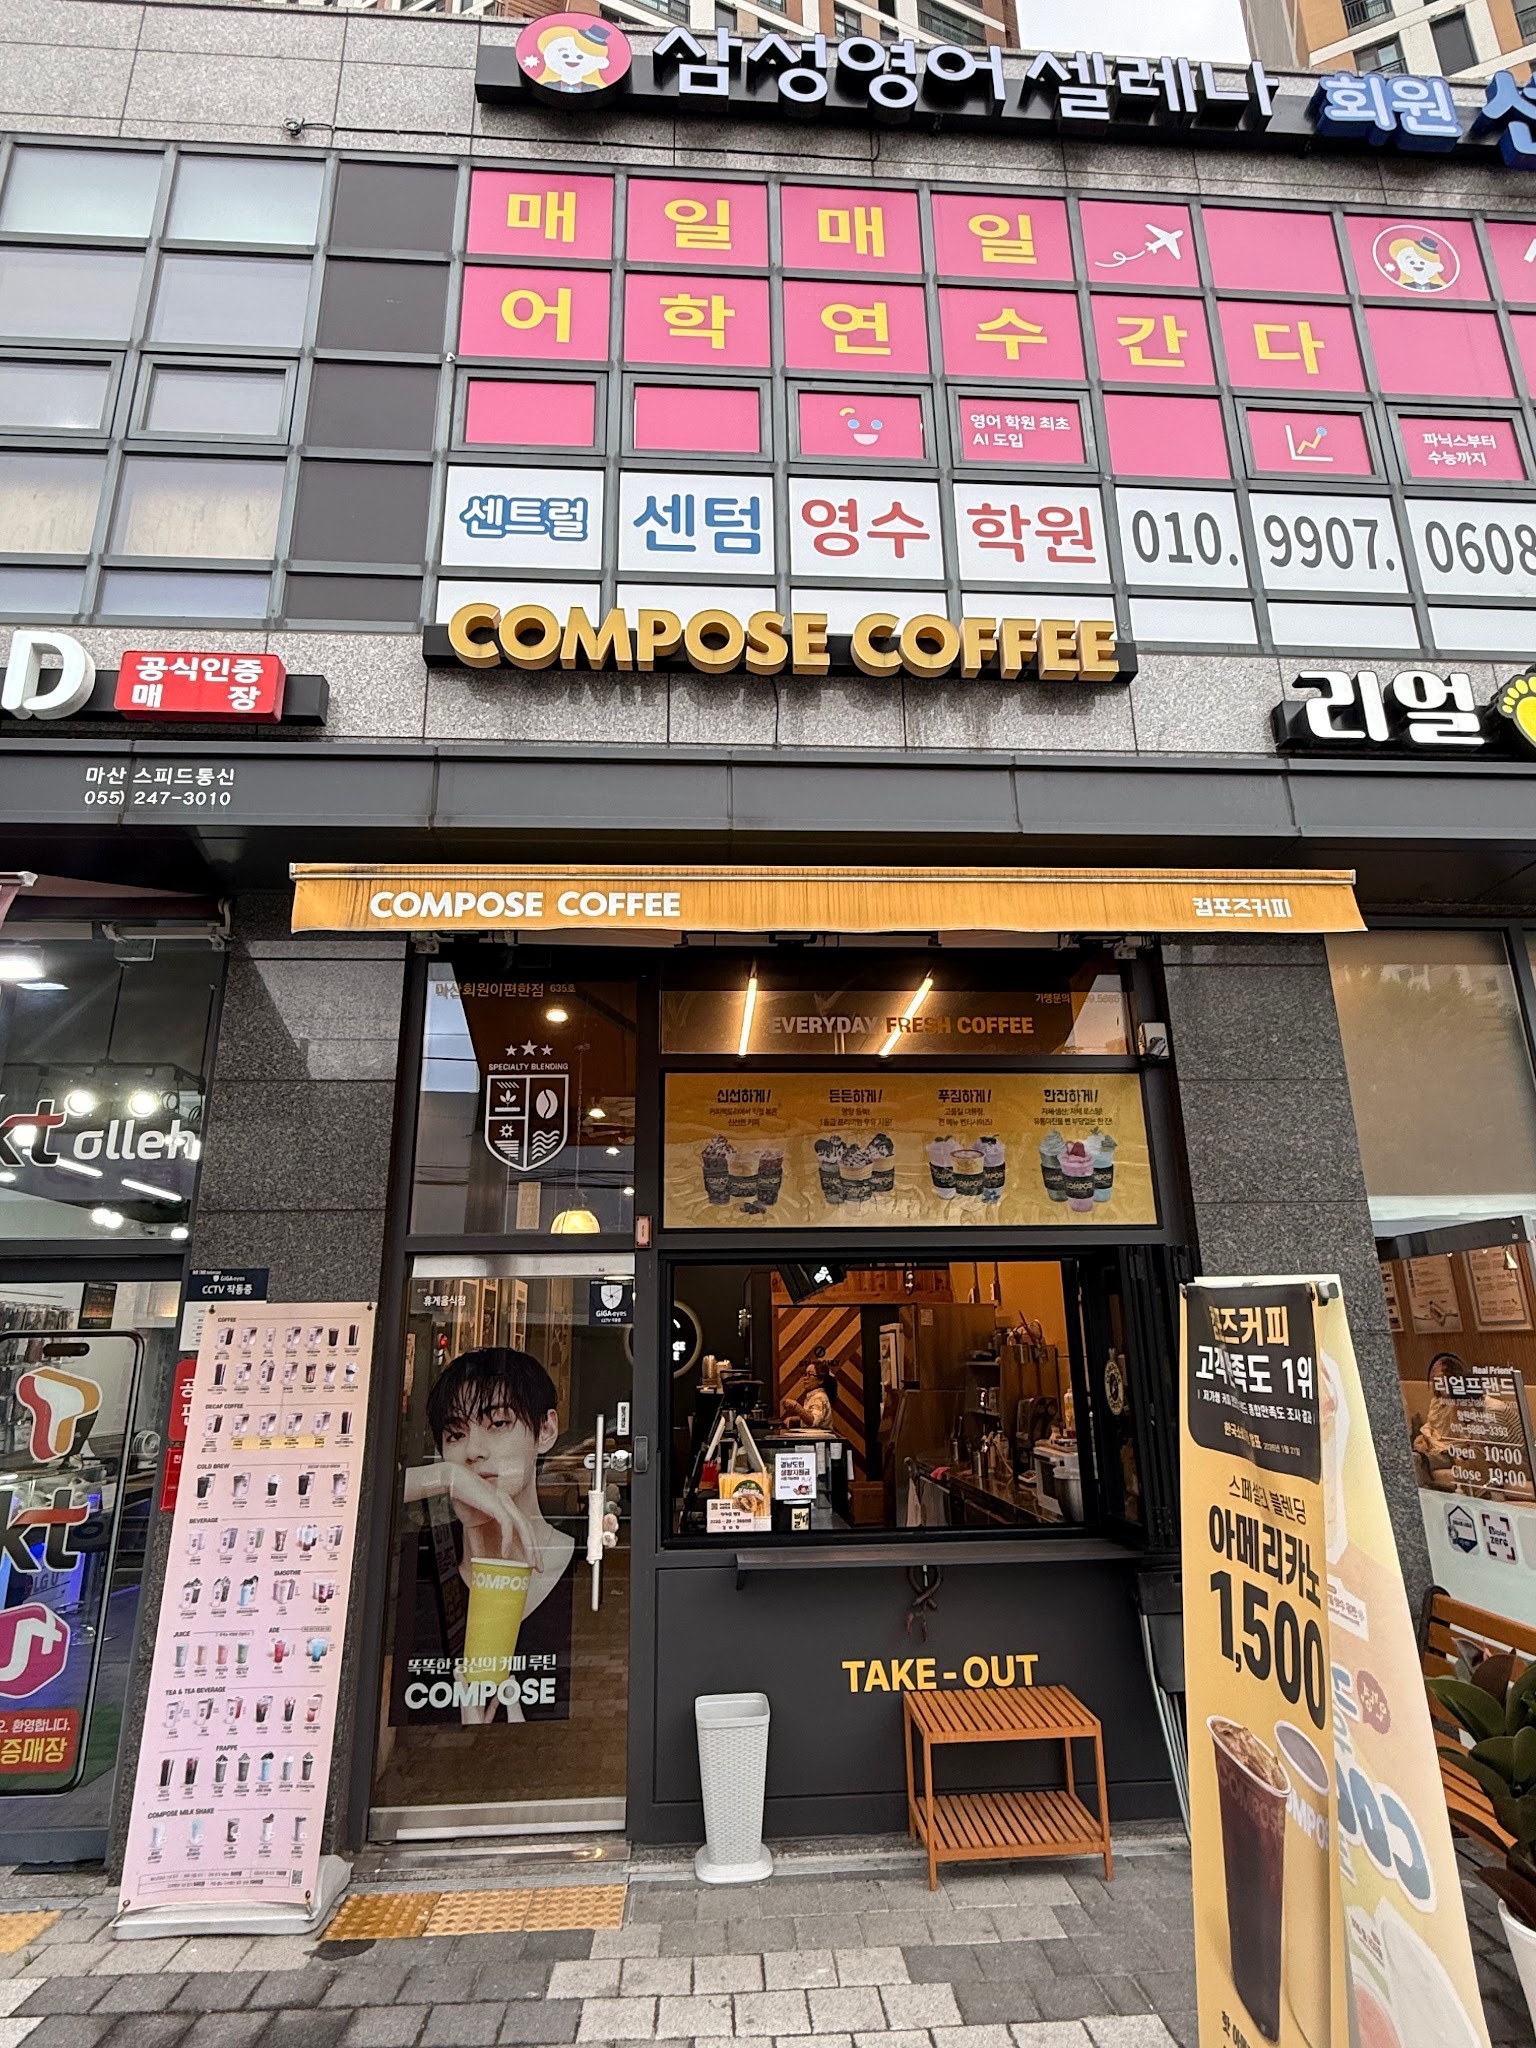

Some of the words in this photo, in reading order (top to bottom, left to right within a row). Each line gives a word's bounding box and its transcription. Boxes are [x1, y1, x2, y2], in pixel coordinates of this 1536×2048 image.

[653, 26, 1006, 108] 삼성영어
[1026, 50, 1279, 120] 셀레나
[1322, 72, 1460, 137] 회원
[970, 413, 1002, 431] 영어
[1005, 414, 1035, 432] 학원
[1039, 414, 1071, 432] 최초
[973, 434, 989, 447] AI
[992, 433, 1024, 449] 도입
[1422, 432, 1497, 450] 파닉스부터
[1427, 449, 1487, 466] 수능까지
[459, 494, 588, 542] 센트럴
[633, 494, 761, 555] 센텀
[801, 498, 931, 559] 영수
[966, 503, 1097, 564] 학원
[448, 602, 830, 675] COMPOSE
[852, 612, 1120, 682] COFFEE
[136, 656, 264, 683] 공식인증
[1297, 668, 1486, 744] 리얼
[85, 767, 127, 785] 마산
[133, 767, 235, 786] 스피드통신
[84, 790, 126, 805] 055)
[134, 791, 232, 806] 247-3010
[370, 891, 543, 918] COMPOSE
[557, 891, 681, 917] COFFEE
[1192, 897, 1292, 918] 컴포즈커피
[768, 1016, 879, 1034] EVERYDAY
[886, 1016, 952, 1034] FRESH
[957, 1016, 1034, 1034] COFFEE
[488, 1063, 530, 1071] SPECIALTY
[531, 1063, 569, 1071] BLENDING
[73, 1119, 201, 1161] olleh
[202, 1285, 226, 1295] CCTV
[227, 1284, 253, 1295] 작동중
[1208, 1305, 1290, 1347] 즈커피
[1282, 1356, 1313, 1400] 1위
[1472, 1365, 1488, 1375] Real
[1433, 1376, 1516, 1396] 리얼프랜드
[1448, 1444, 1476, 1460] Open
[1484, 1445, 1523, 1466] 10:00
[1451, 1465, 1482, 1481] Close
[1208, 1504, 1322, 1611] 아메리카노
[1209, 1570, 1327, 1731] 1,500
[407, 1658, 452, 1675] 똑똑한
[454, 1656, 497, 1674] 당신의
[499, 1655, 526, 1671] 커피
[528, 1653, 557, 1671] 루틴
[841, 1654, 1039, 1693] TAKE-OUT
[404, 1677, 557, 1710] COMPOSE
[148, 1809, 179, 1819] COMPOSE
